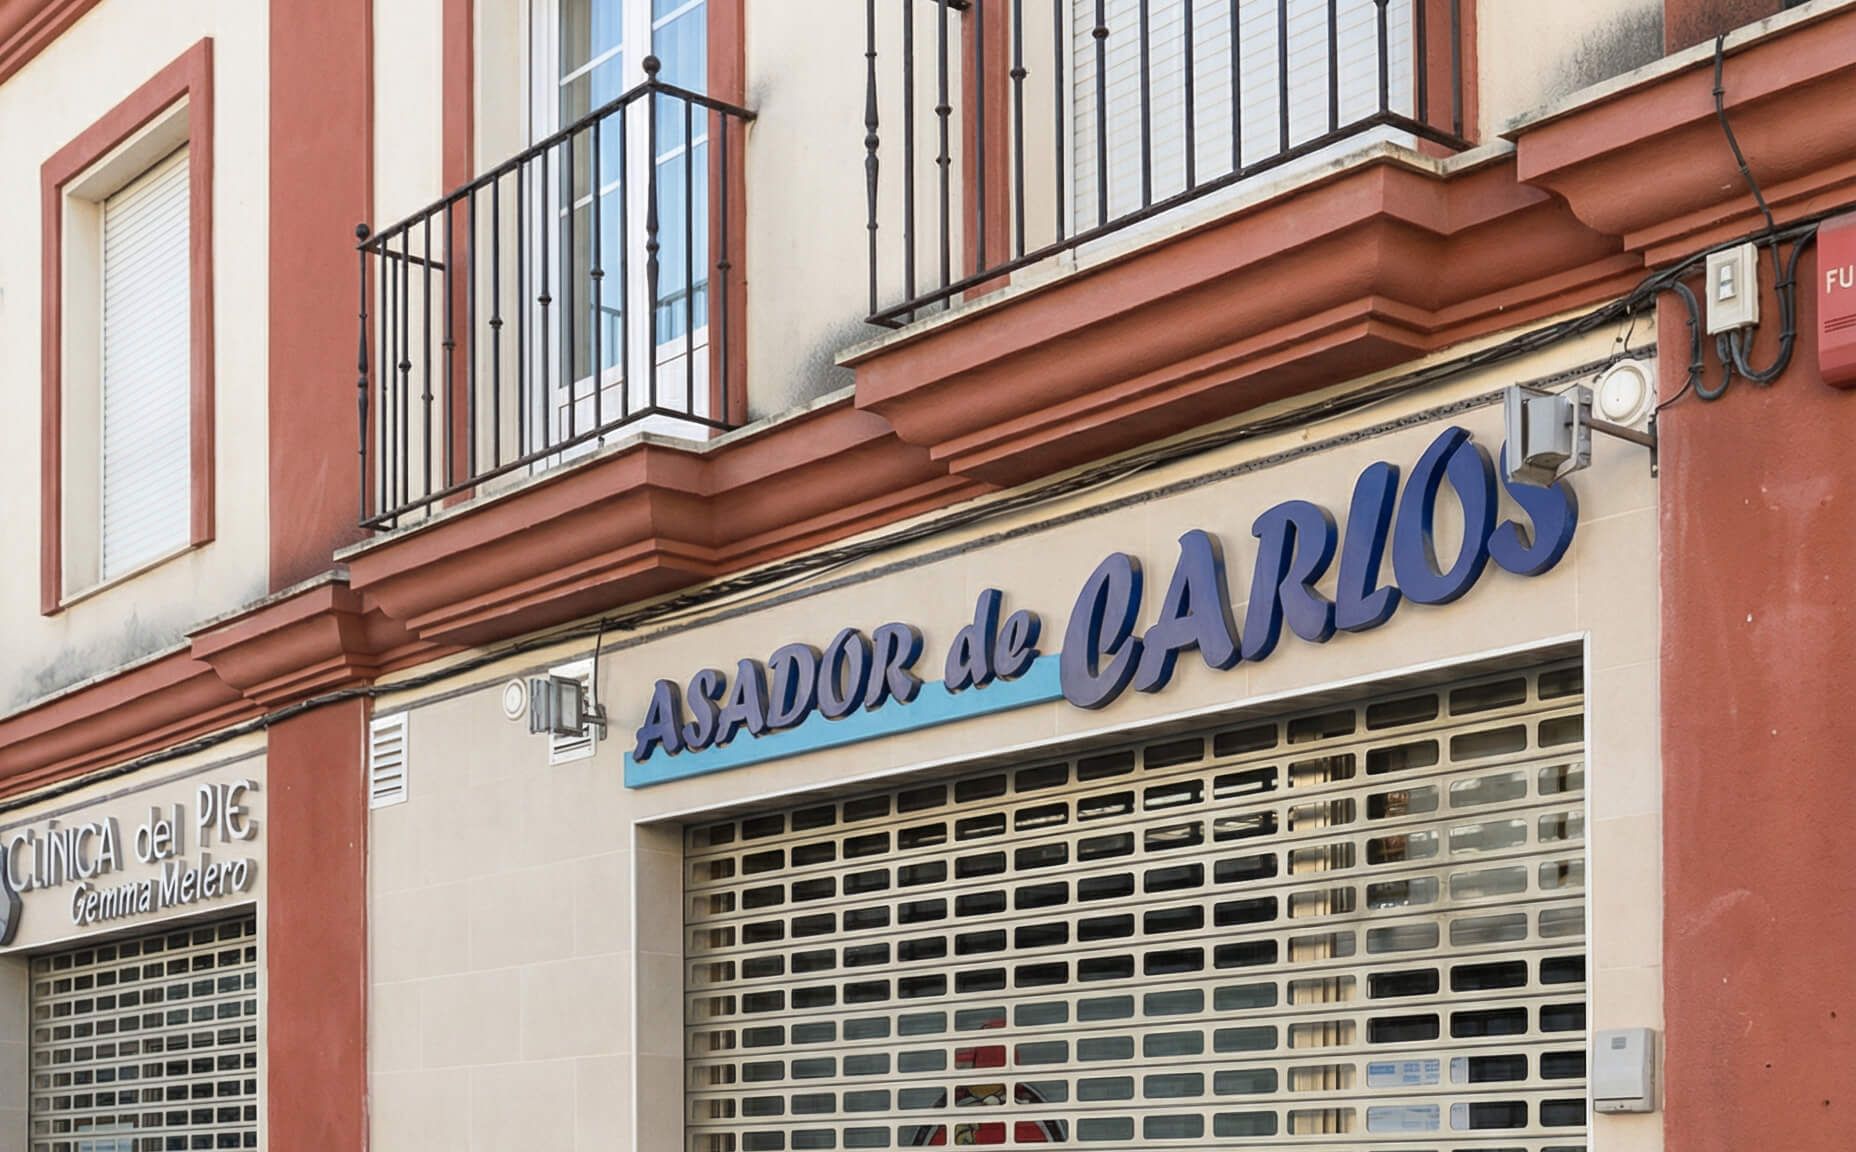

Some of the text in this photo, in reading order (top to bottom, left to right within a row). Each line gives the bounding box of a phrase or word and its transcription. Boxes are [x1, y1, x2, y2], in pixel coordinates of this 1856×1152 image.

[633, 426, 1579, 763] ASADOR de CARLOS
[6, 779, 259, 893] CLÍNICA del PIE
[71, 852, 257, 926] Gemma Melero
